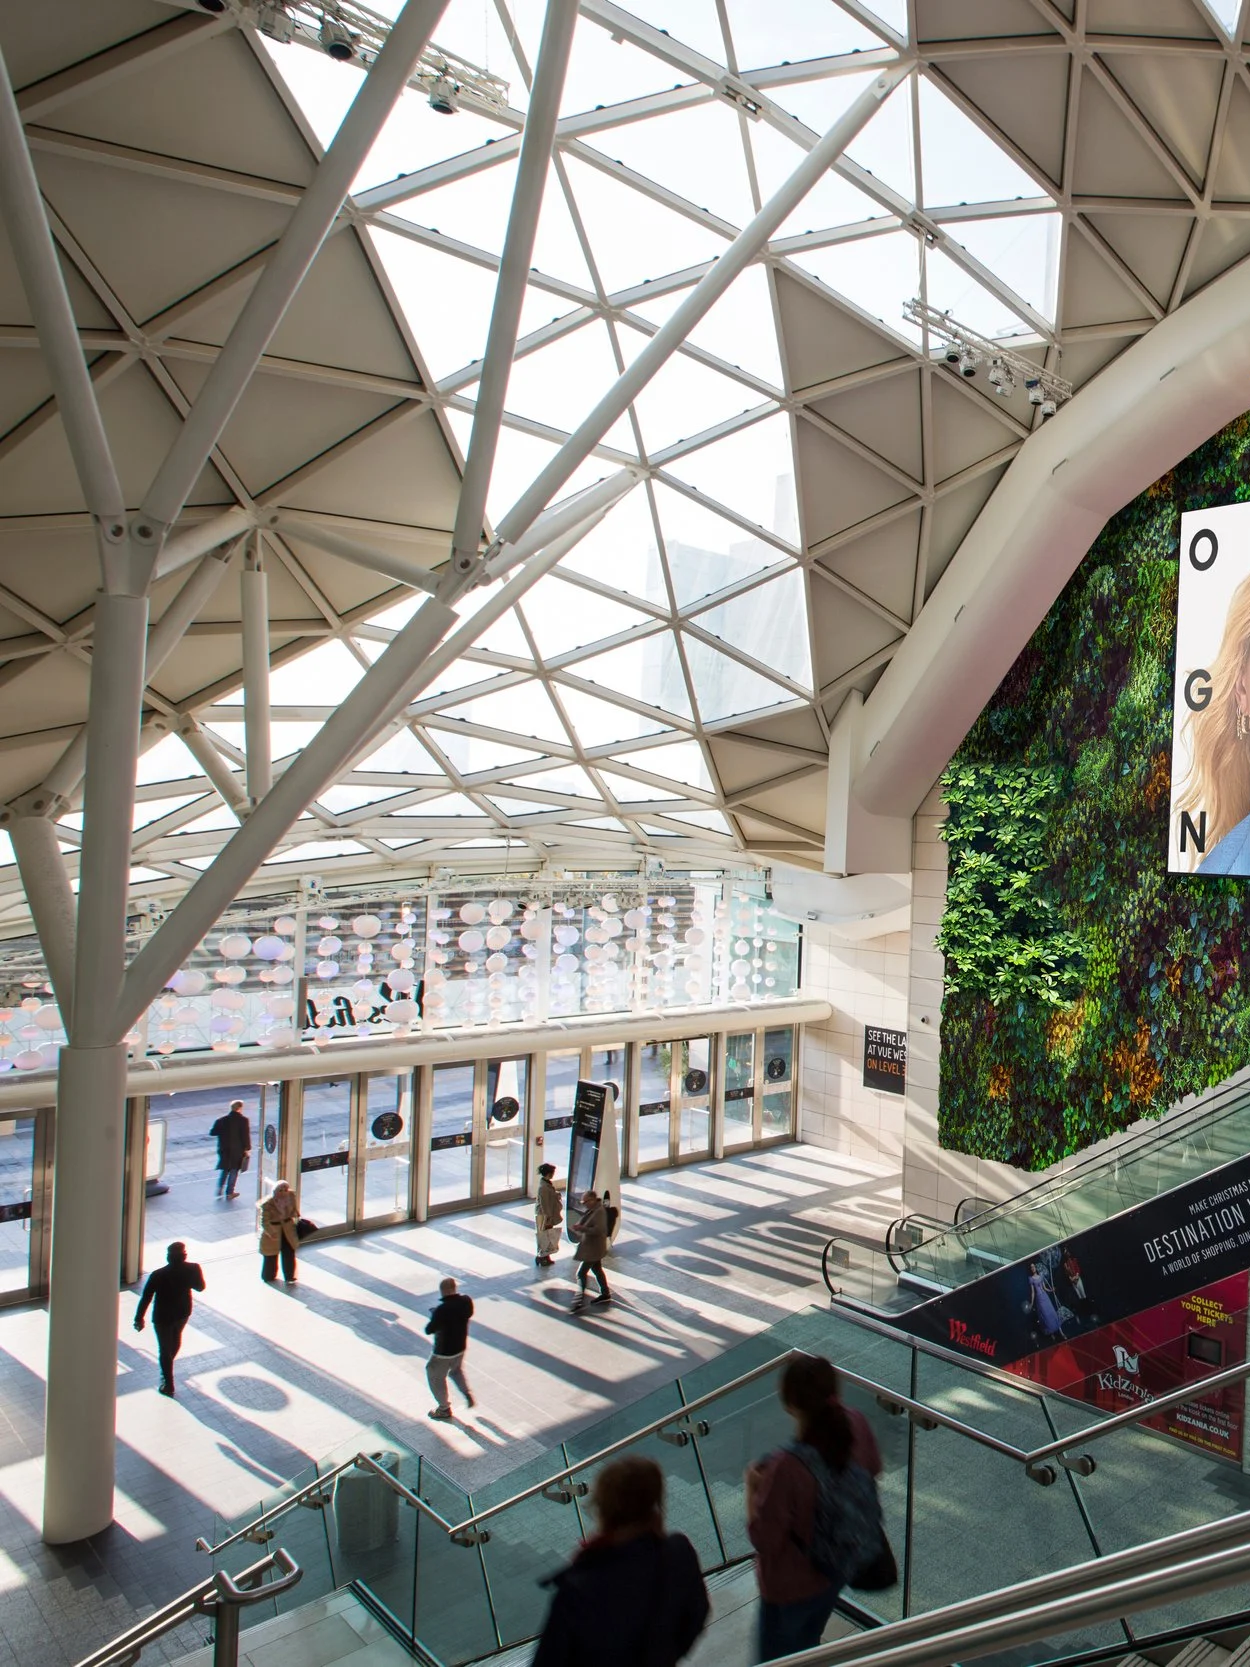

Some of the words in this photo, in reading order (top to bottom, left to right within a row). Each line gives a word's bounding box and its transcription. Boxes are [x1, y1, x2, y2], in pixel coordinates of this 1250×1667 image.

[1188, 529, 1219, 572] O
[1184, 669, 1213, 712] G
[1180, 811, 1207, 853] N
[867, 1044, 876, 1055] AT
[877, 1045, 892, 1059] VUE
[868, 1030, 881, 1043] SEE
[882, 1032, 897, 1045] THE
[867, 1058, 877, 1070] ON
[879, 1061, 900, 1075] LEVEL
[1188, 1199, 1209, 1216] MAKE
[1208, 1182, 1249, 1207] CHRISTMAS
[1144, 1203, 1246, 1263] DESTINATION
[1162, 1265, 1169, 1276] A
[1168, 1256, 1192, 1274] WORLD
[1191, 1252, 1201, 1264] OF
[1202, 1237, 1240, 1261] SHOPPING,
[1180, 1300, 1202, 1314] YOUR
[1203, 1307, 1233, 1324] TICKETS
[1191, 1295, 1223, 1310] COLLECT
[1196, 1314, 1217, 1327] HERE
[949, 1318, 998, 1357] Westfield
[1176, 1413, 1230, 1439] KIDZANIA.CO.UK
